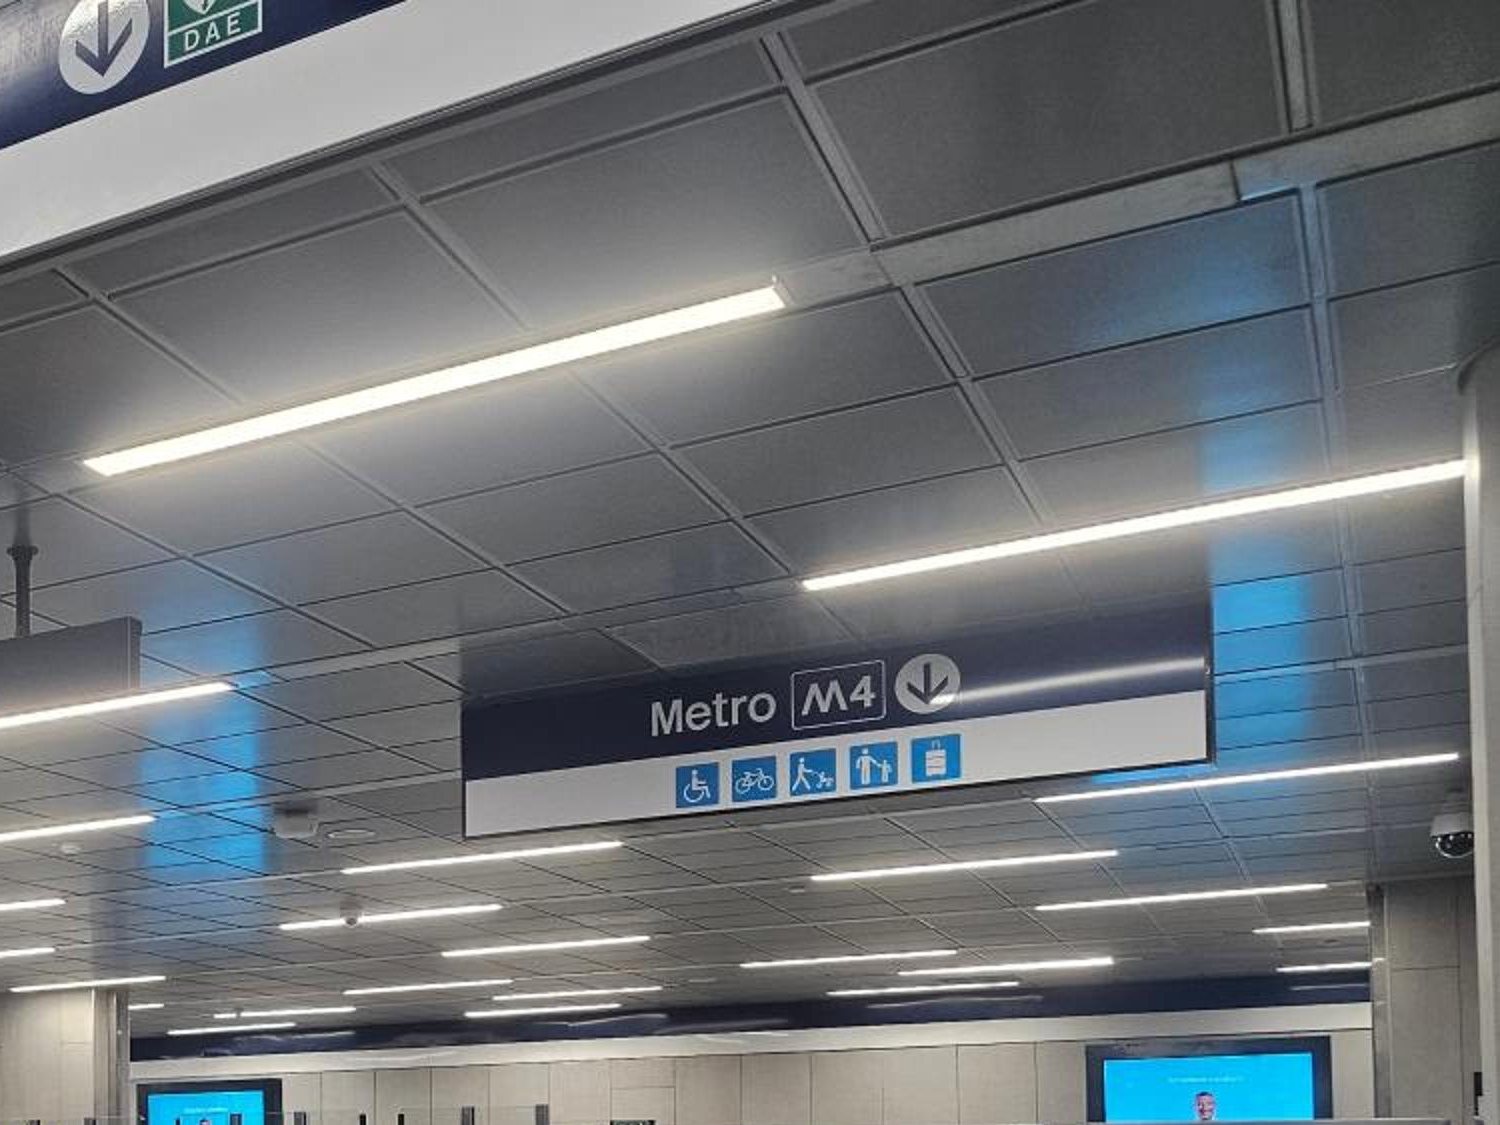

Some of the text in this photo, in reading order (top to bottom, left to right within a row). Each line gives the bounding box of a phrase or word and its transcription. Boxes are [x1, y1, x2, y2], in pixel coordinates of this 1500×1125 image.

[184, 16, 243, 51] DAE
[651, 675, 876, 737] Metro M4
